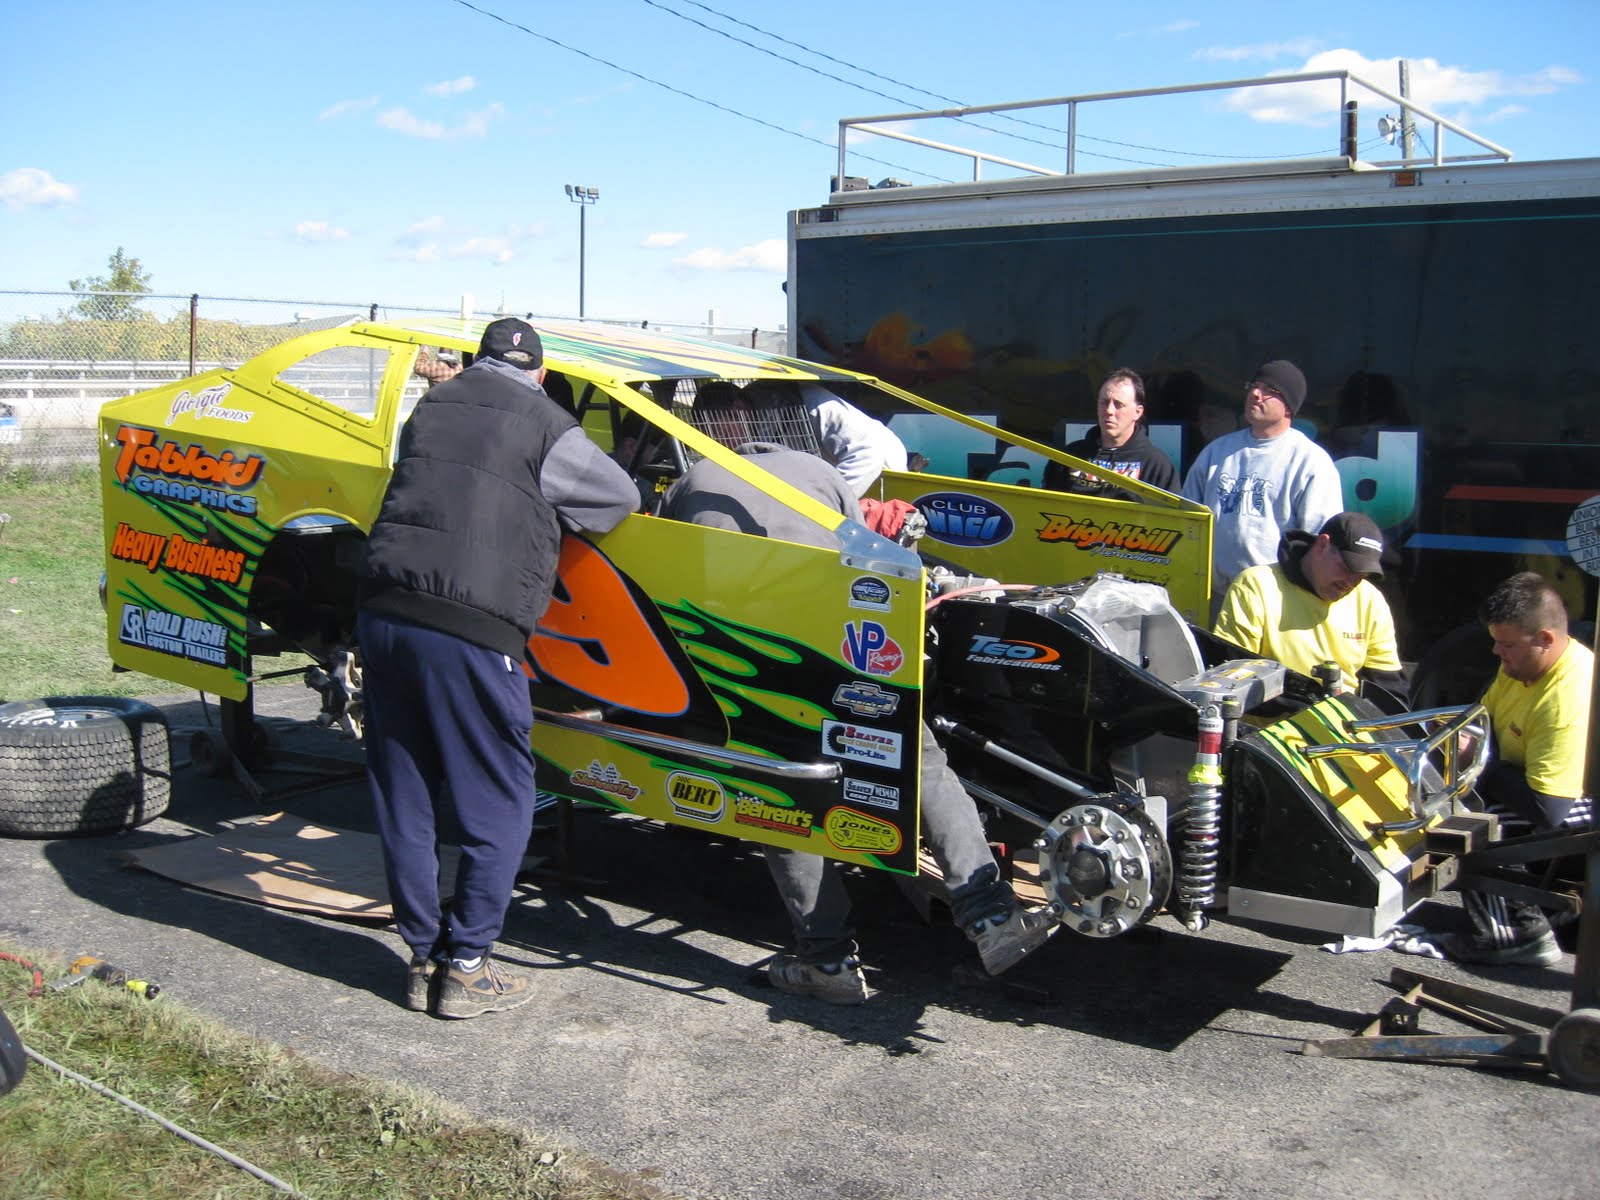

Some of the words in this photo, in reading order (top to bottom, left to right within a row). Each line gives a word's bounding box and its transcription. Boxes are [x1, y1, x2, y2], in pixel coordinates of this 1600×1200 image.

[207, 407, 252, 421] FOODS
[115, 425, 264, 490] Tabloid
[133, 475, 257, 514] GRAPHICS
[932, 500, 986, 515] CLUB
[1036, 512, 1183, 556] Brightbill
[112, 523, 167, 572] Heavy
[166, 534, 246, 584] Business
[145, 609, 182, 637] GOLD
[181, 617, 224, 646] RUSH
[146, 634, 184, 654] CUSTOM
[184, 643, 227, 665] TRAILERS
[844, 620, 886, 673] VP
[966, 654, 1062, 671] Fabrications
[672, 781, 720, 807] BERT
[737, 798, 813, 829] Behrent's
[838, 821, 891, 835] JONES
